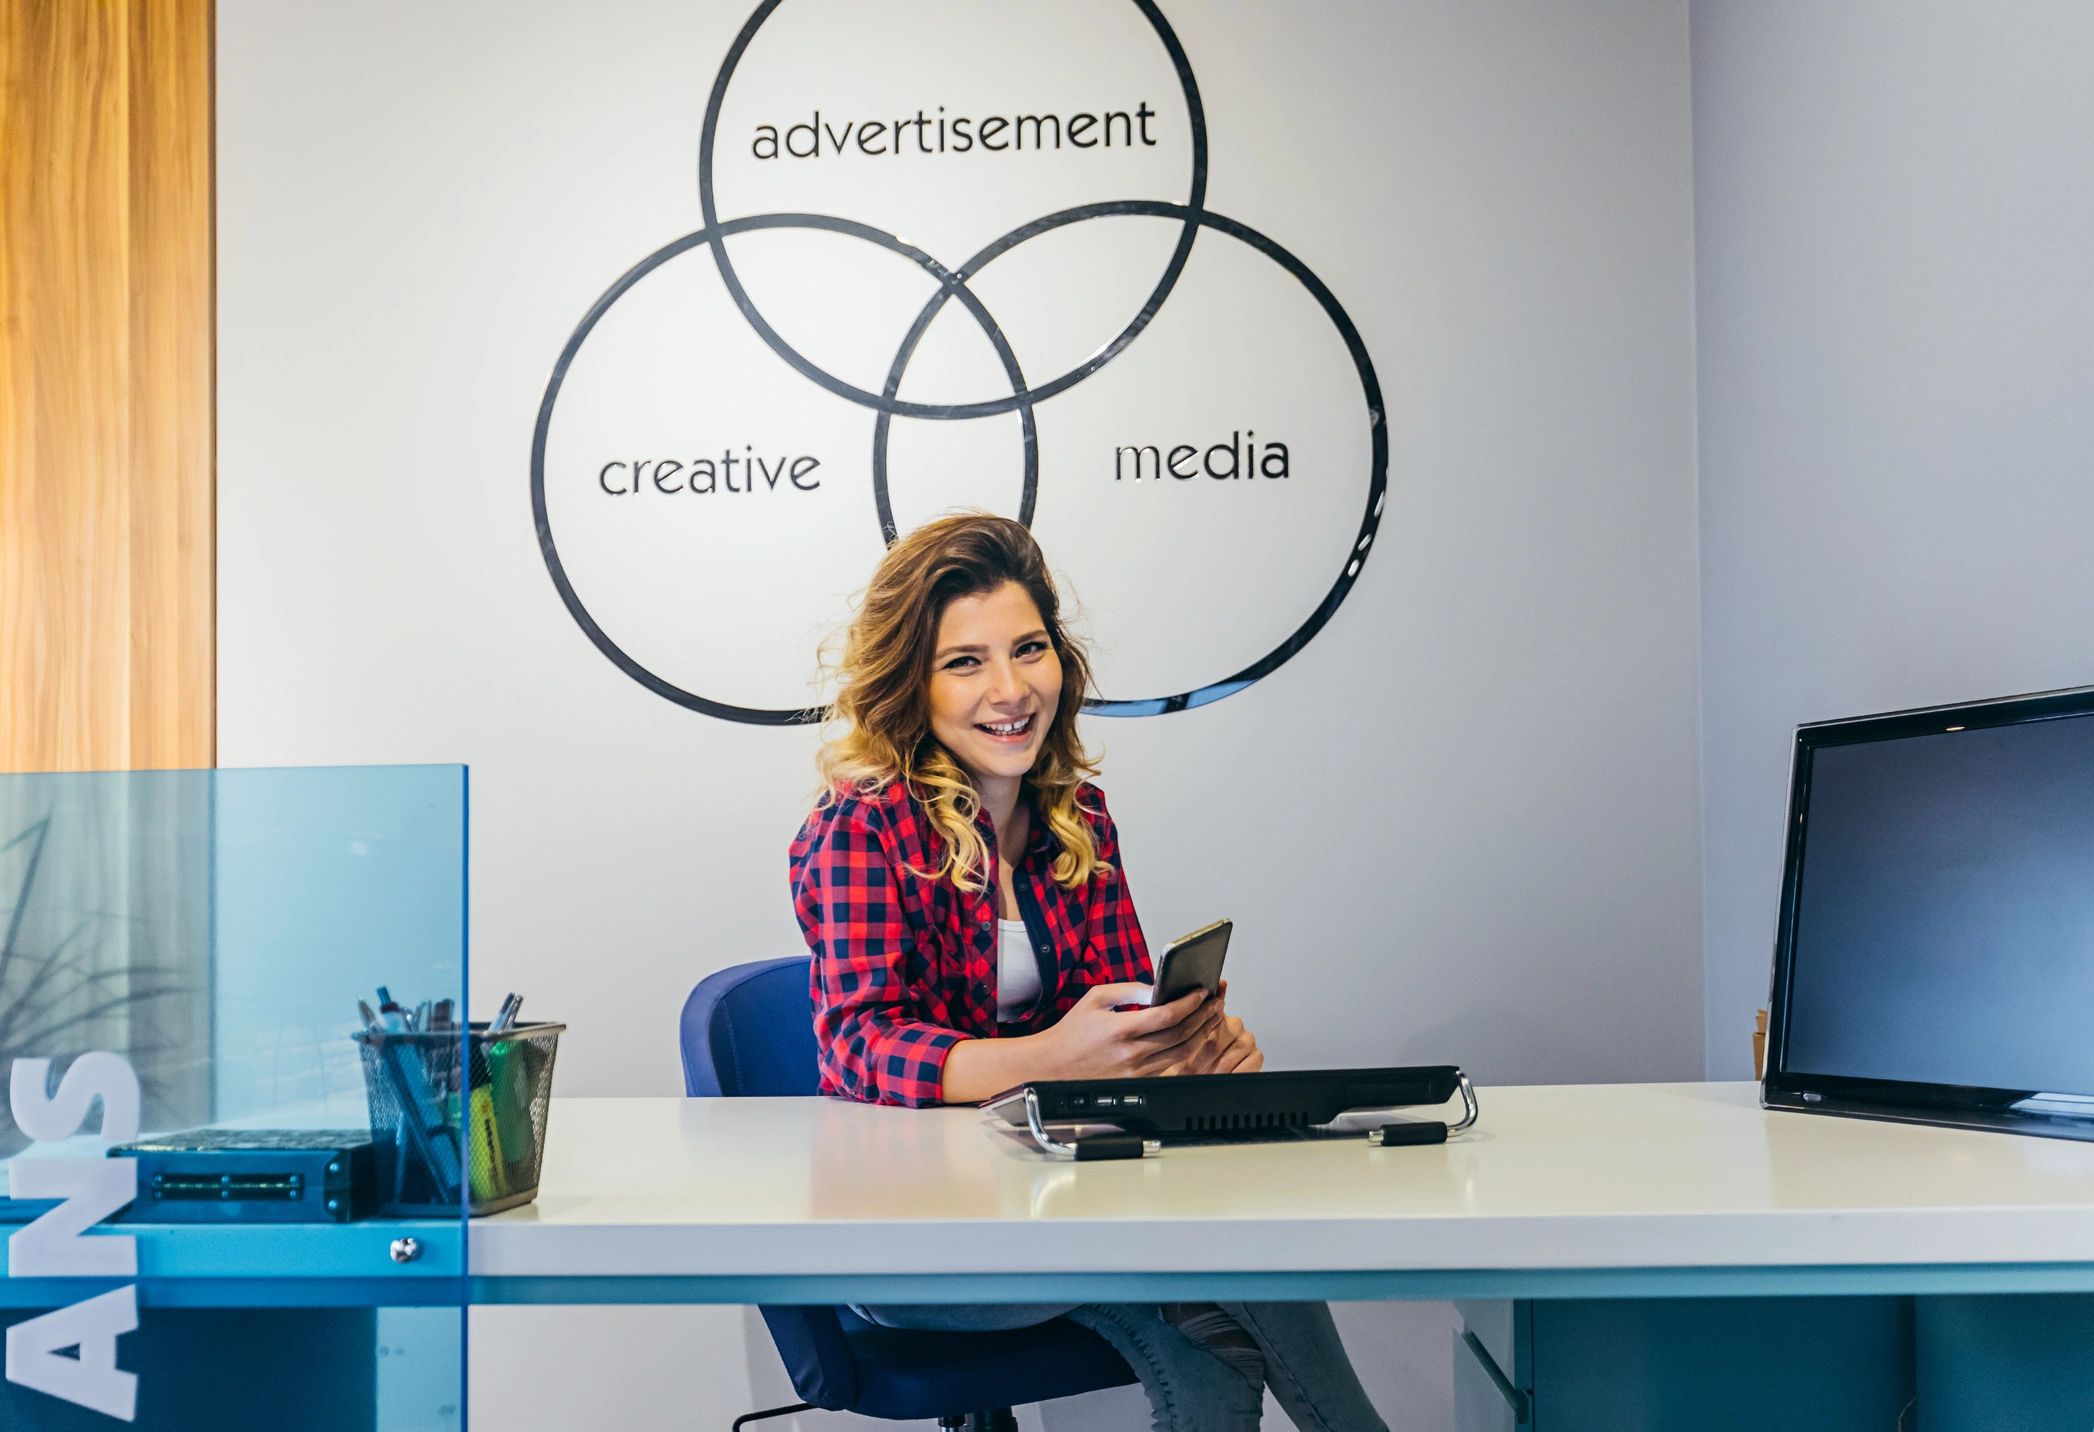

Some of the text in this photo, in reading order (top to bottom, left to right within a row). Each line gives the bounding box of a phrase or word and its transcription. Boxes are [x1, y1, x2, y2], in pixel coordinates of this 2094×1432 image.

[752, 101, 1157, 160] advertisement
[600, 445, 821, 495] creative
[1115, 430, 1289, 481] media
[5, 1052, 140, 1422] ANS
